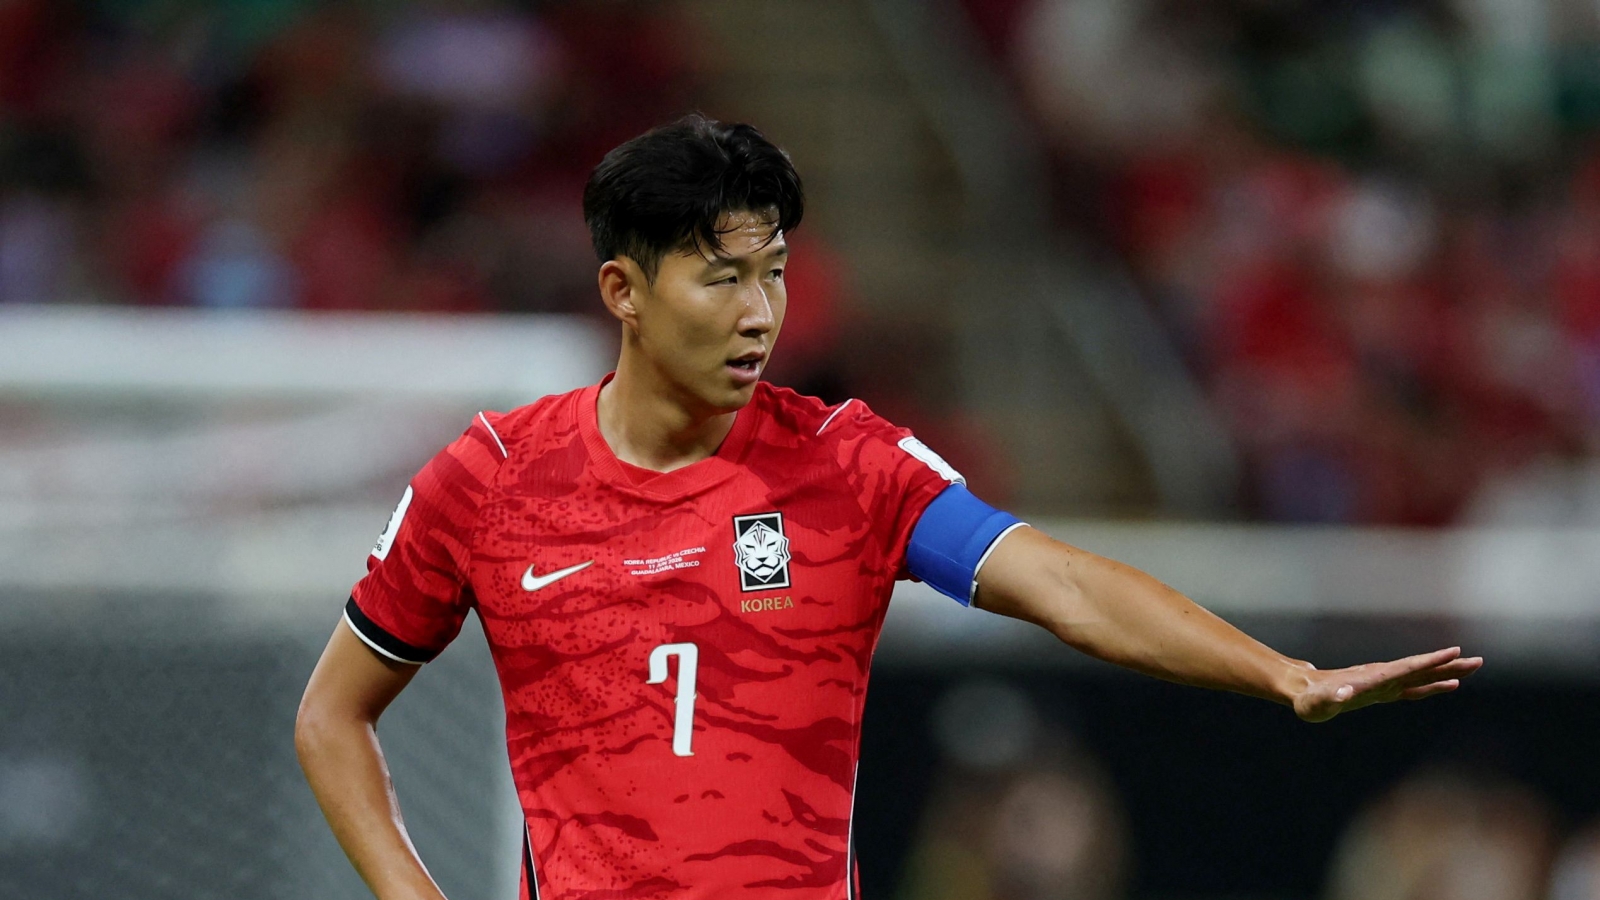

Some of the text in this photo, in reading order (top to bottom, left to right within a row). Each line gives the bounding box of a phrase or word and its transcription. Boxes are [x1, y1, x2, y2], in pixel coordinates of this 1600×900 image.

[645, 554, 672, 565] REPUBLIC
[680, 546, 706, 556] CZECHIA
[668, 556, 683, 564] 2026
[675, 560, 700, 569] MEXICO
[741, 595, 794, 613] KOREA
[645, 642, 698, 757] 7
